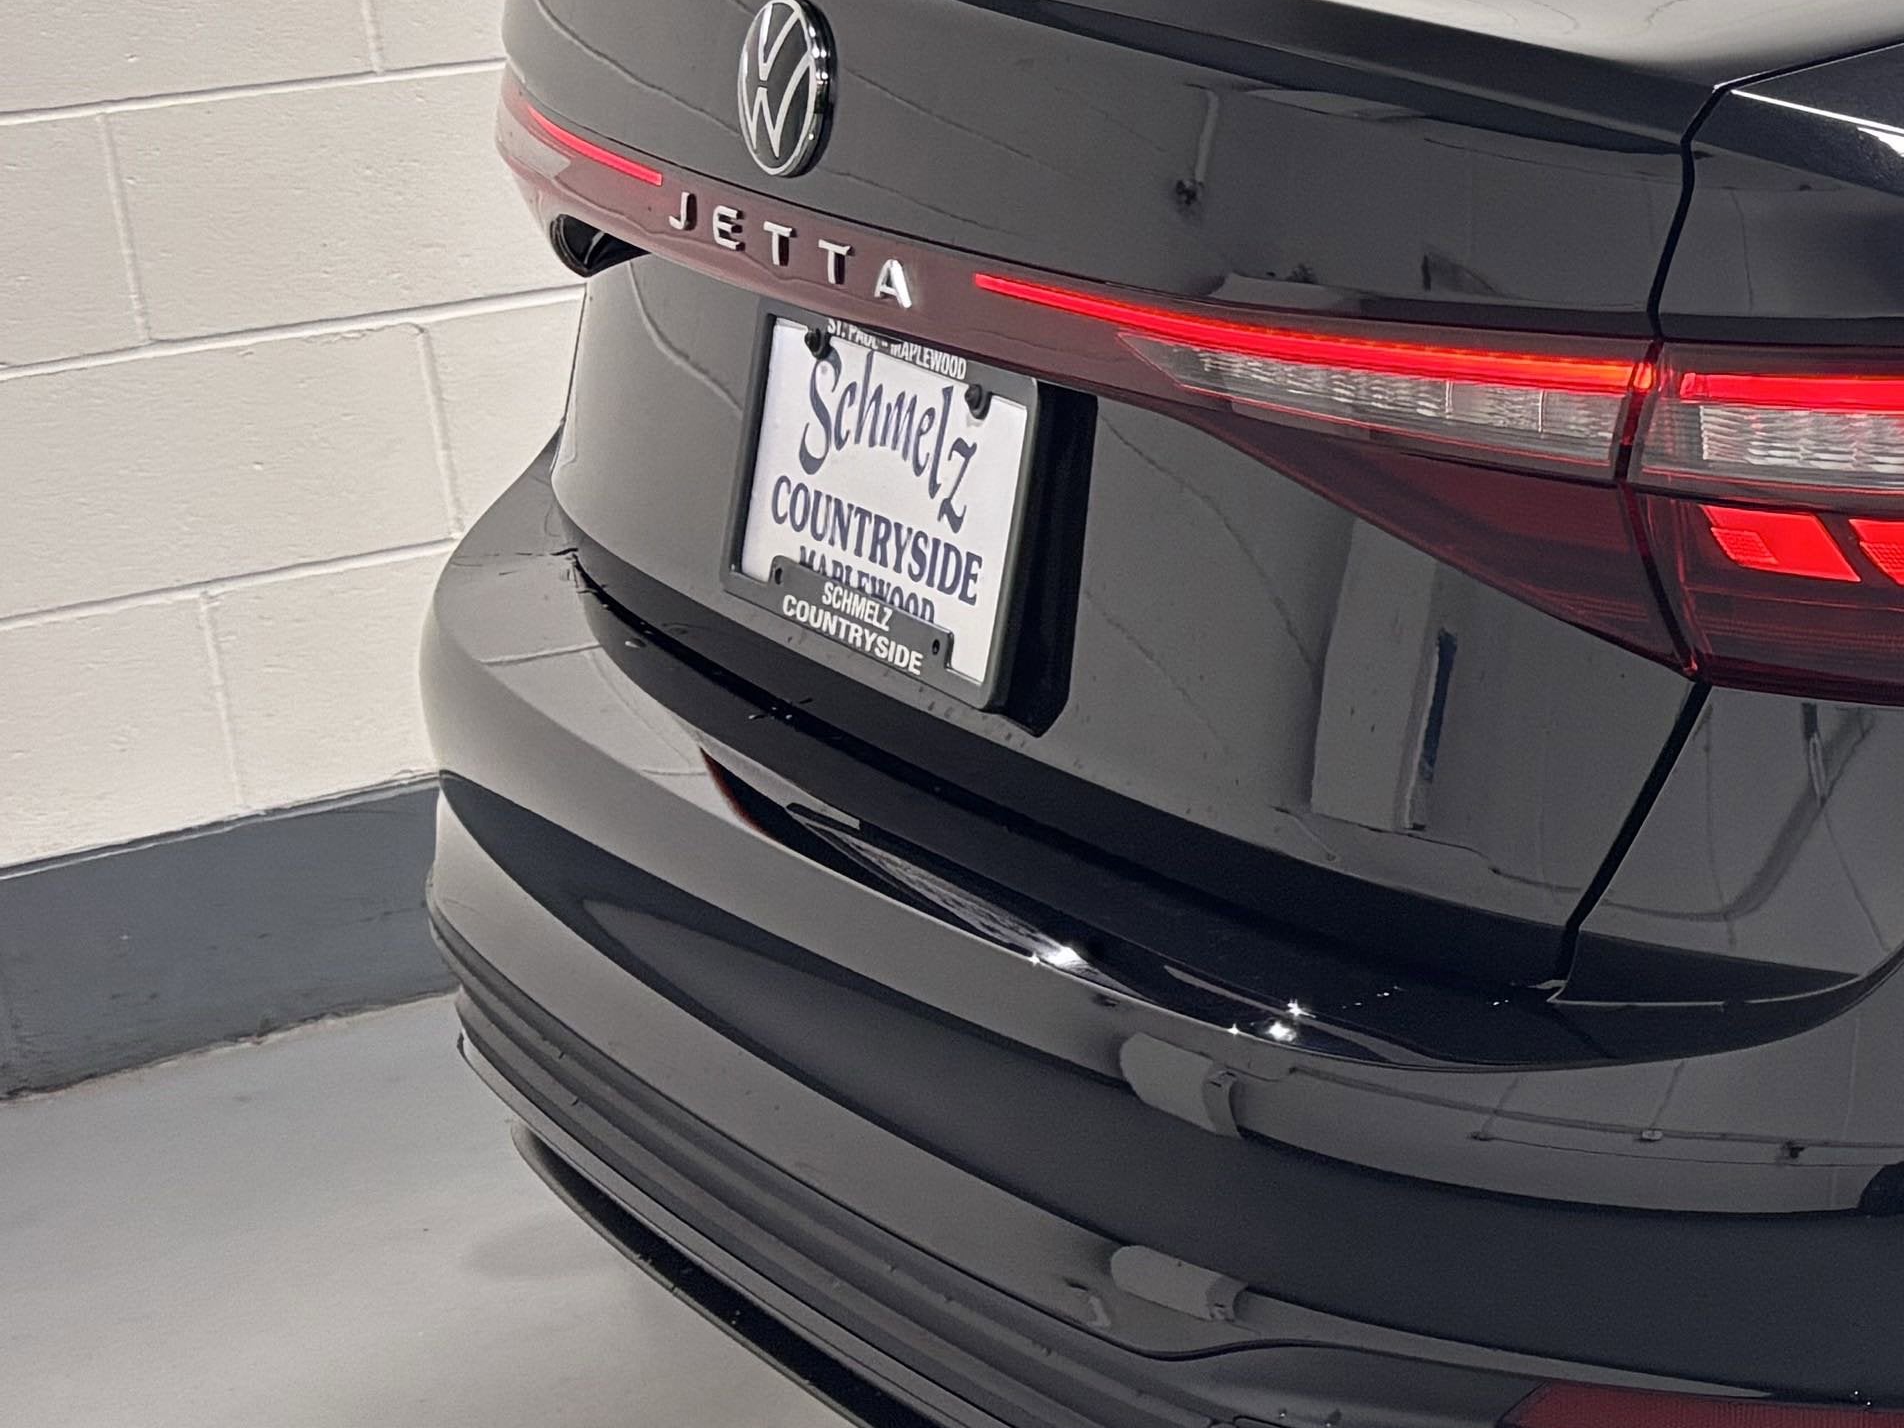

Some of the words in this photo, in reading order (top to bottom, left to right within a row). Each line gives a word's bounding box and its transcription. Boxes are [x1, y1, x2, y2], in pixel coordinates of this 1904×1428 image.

[668, 191, 914, 309] JETTA
[890, 341, 967, 381] MAPLEWOOD
[799, 345, 978, 534] Schmelz
[771, 475, 983, 606] COUNTRYSIDE
[782, 594, 924, 676] COUNTRYSIDE
[821, 581, 894, 632] SCHMELZ
